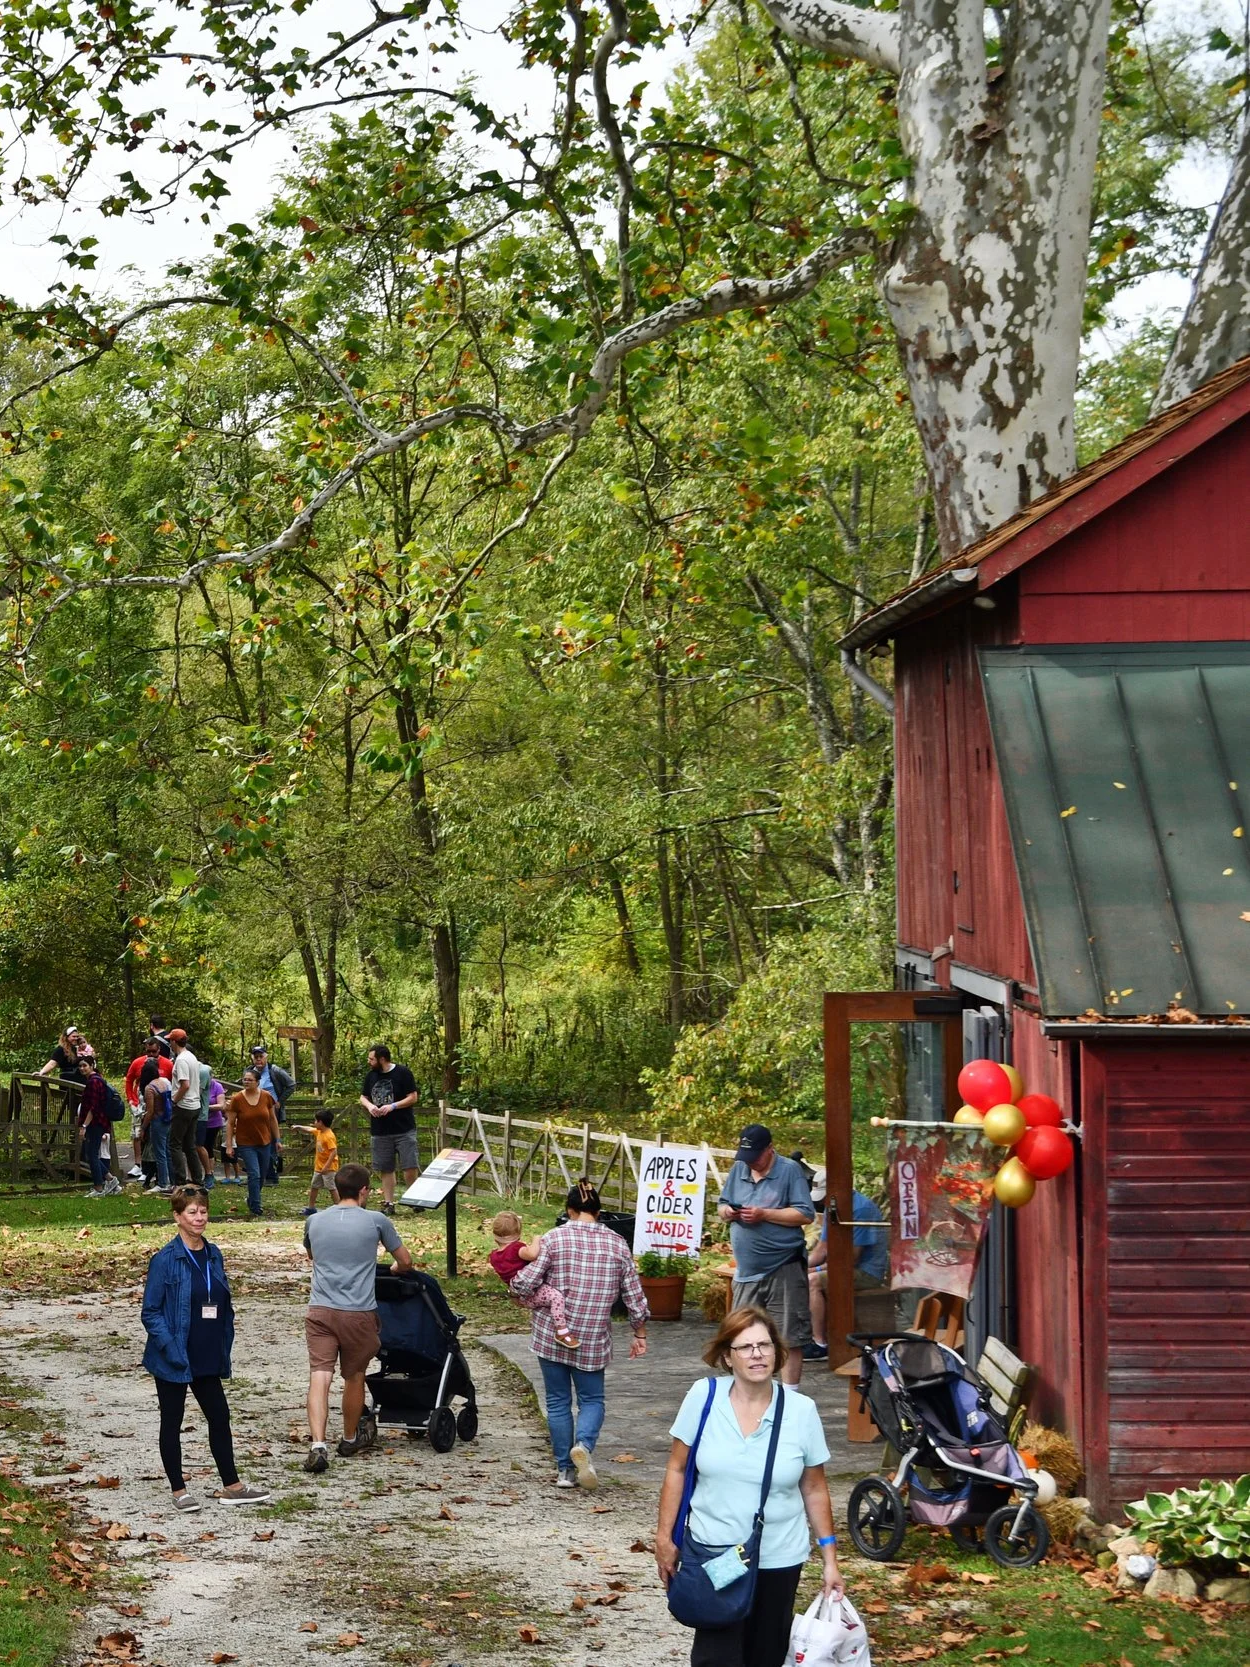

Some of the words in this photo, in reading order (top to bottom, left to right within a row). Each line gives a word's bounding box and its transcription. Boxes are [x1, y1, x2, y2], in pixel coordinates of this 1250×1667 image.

[644, 1157, 697, 1182] APPLES
[662, 1180, 675, 1197] &
[647, 1195, 693, 1215] CIDER
[645, 1221, 693, 1239] INSIDE
